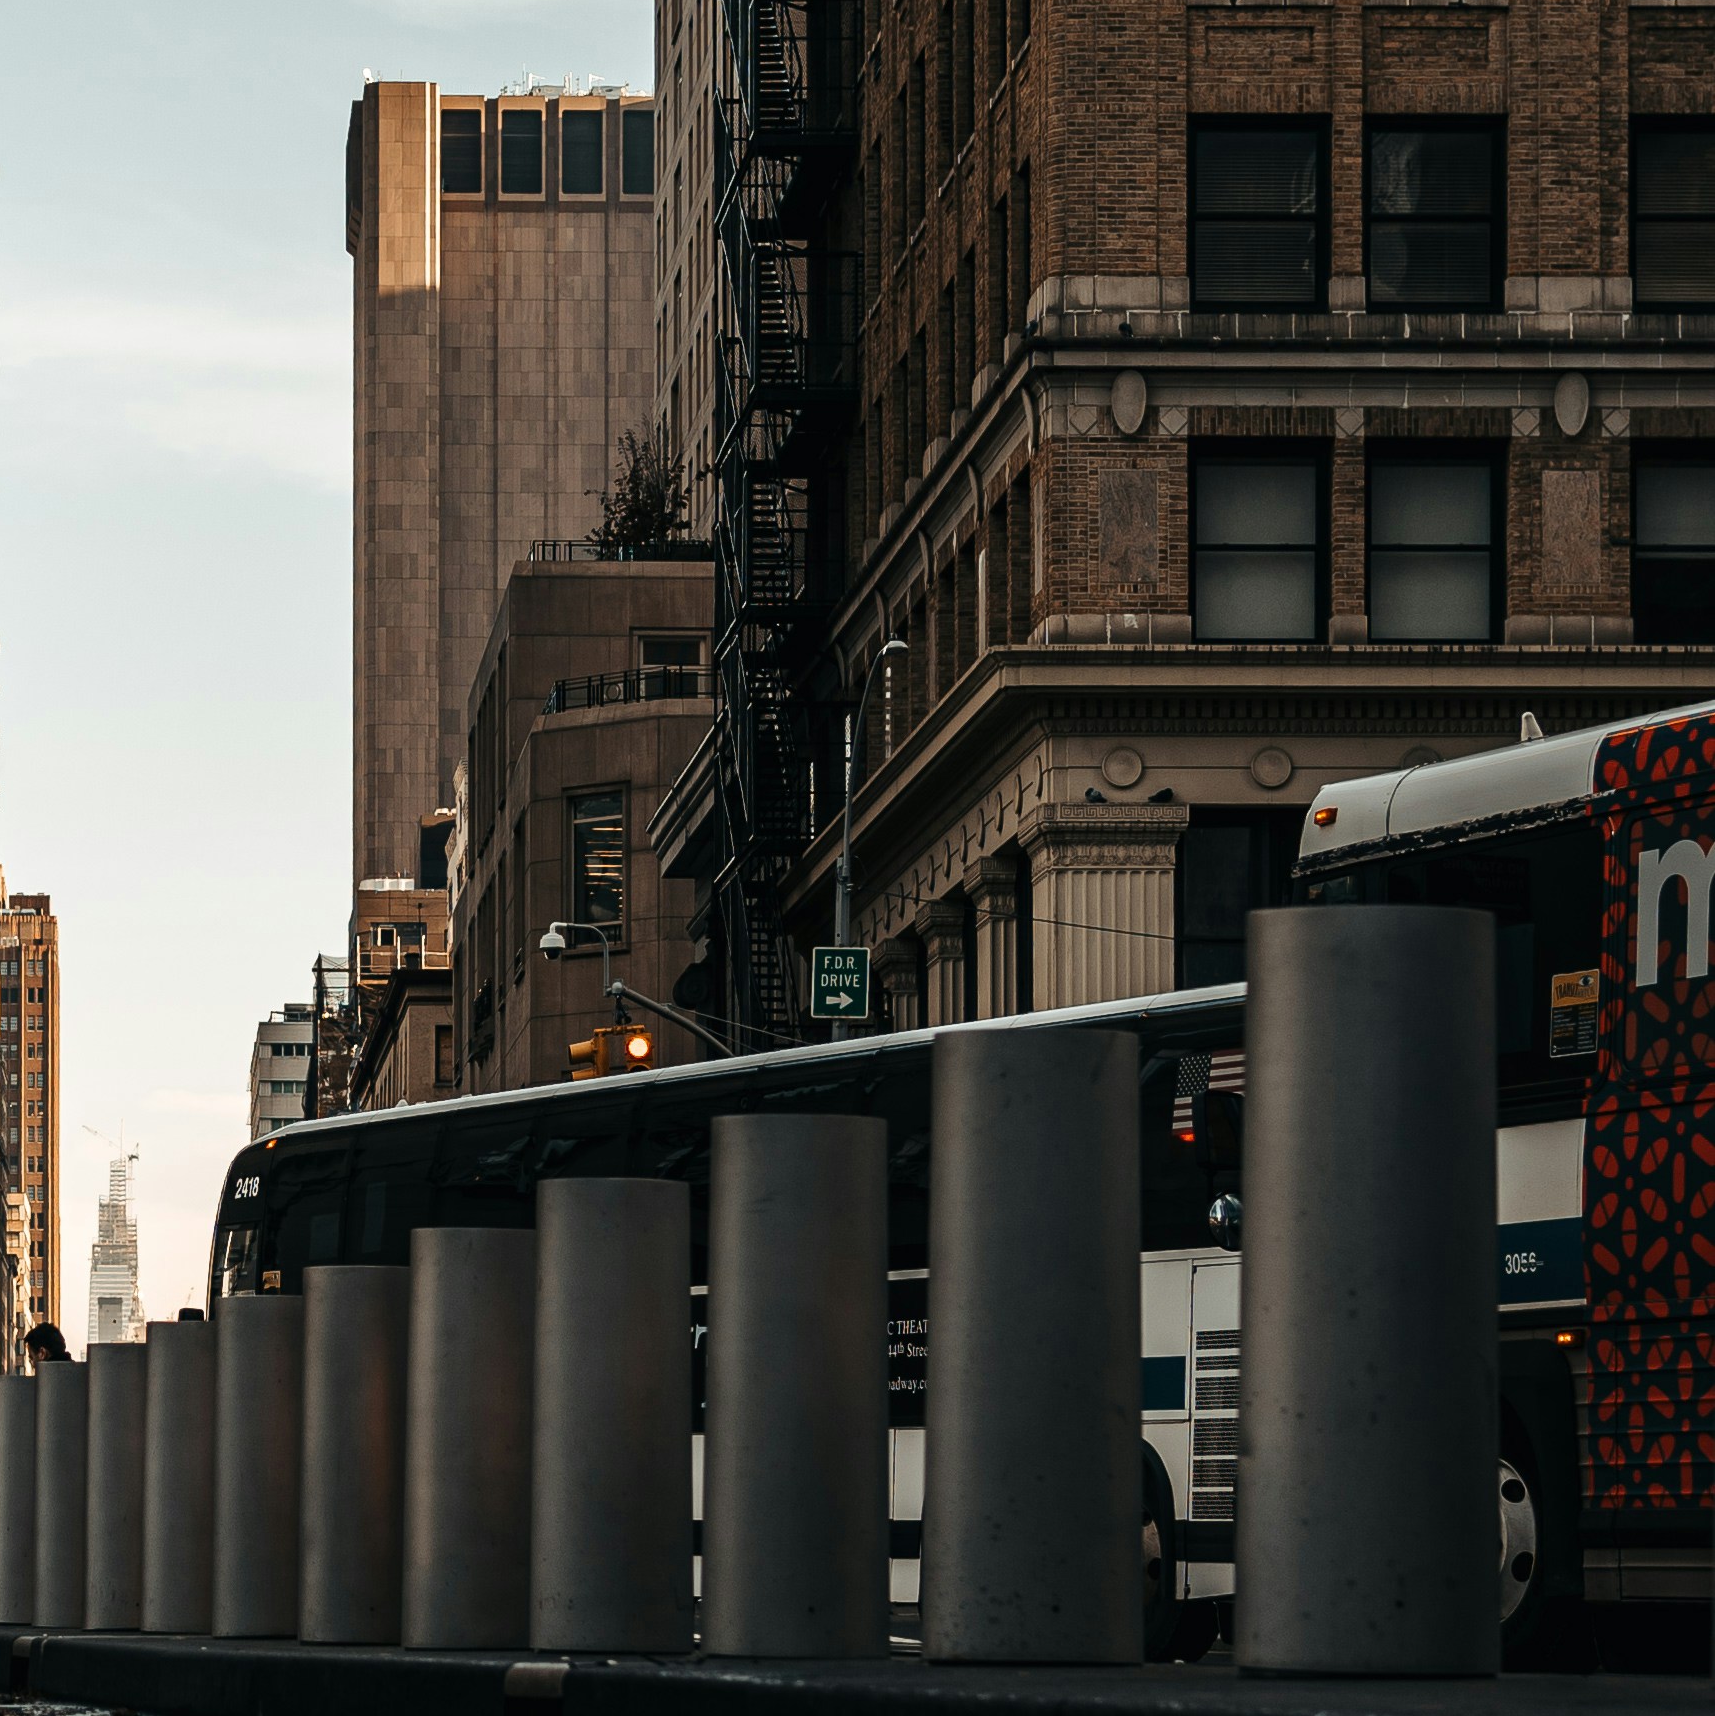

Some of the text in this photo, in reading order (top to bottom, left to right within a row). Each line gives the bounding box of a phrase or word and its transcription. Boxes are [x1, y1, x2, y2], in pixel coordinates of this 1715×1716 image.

[824, 956, 858, 970] F.D.R.
[821, 973, 861, 988] DRIVE
[234, 1175, 260, 1200] 2418
